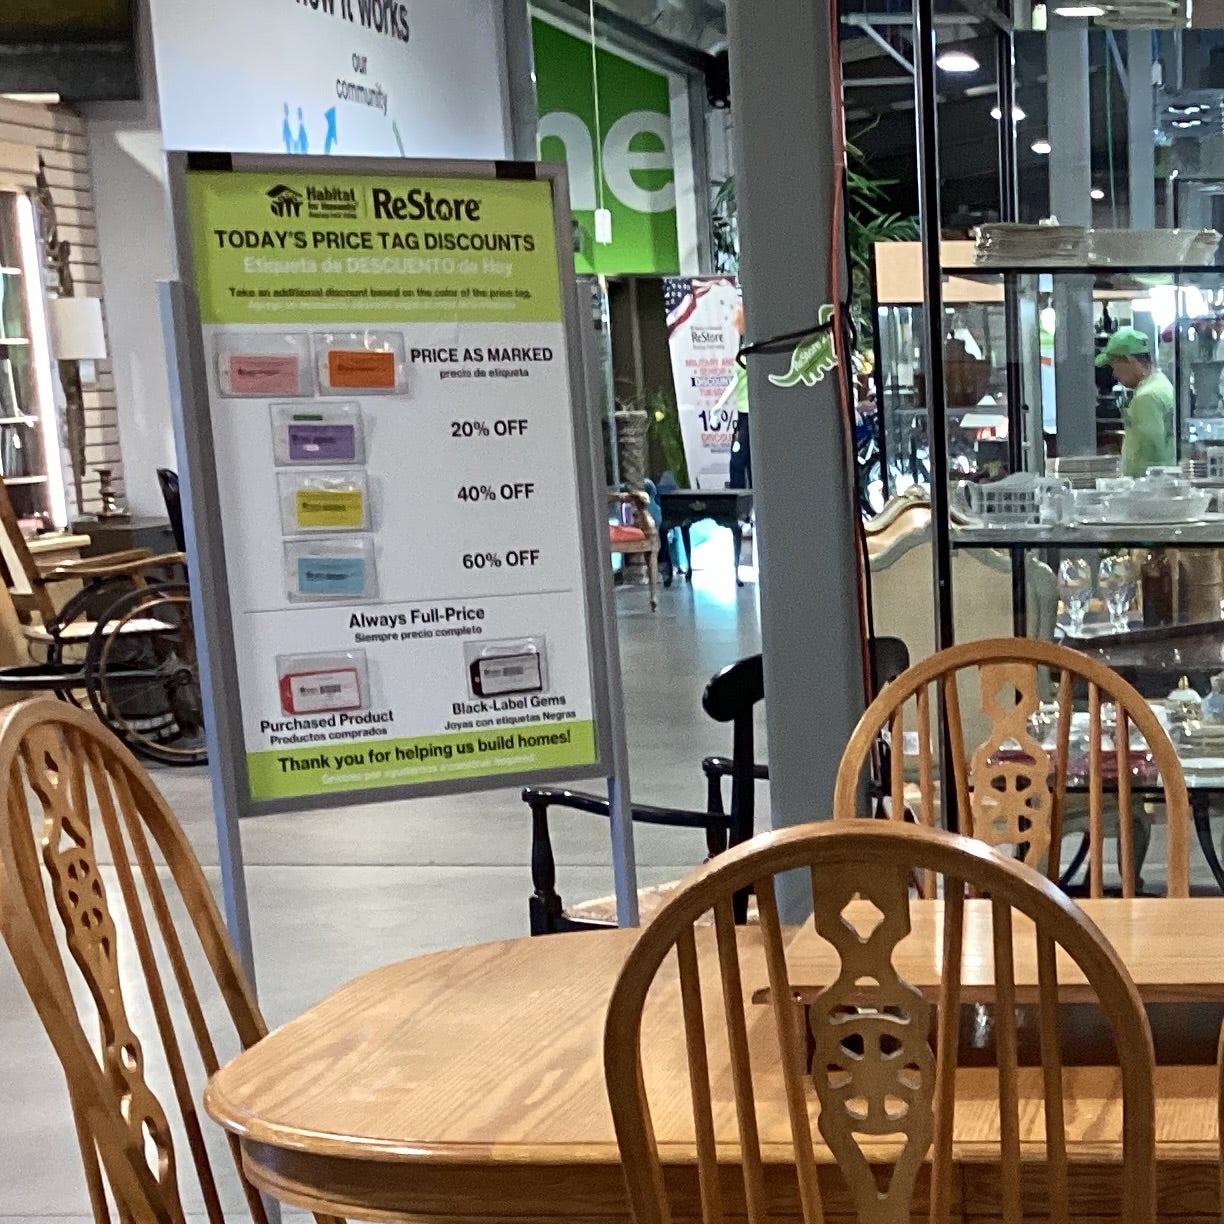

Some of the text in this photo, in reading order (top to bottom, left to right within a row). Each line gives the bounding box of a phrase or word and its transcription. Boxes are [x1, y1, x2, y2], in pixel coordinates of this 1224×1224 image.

[358, 0, 410, 43] works
[352, 52, 368, 75] our
[336, 78, 388, 117] community
[306, 185, 481, 222] Habitat ReStore
[214, 229, 536, 252] TODAY'S PRICE TAG DISCOUNTS
[347, 257, 455, 274] DESCUENTO
[228, 286, 256, 298] Take
[258, 288, 272, 298] an
[273, 287, 323, 298] additional
[325, 287, 368, 298] discount
[370, 287, 400, 298] based
[402, 289, 415, 298] on
[416, 288, 432, 298] the
[460, 287, 471, 298] of
[472, 287, 488, 298] the
[489, 289, 513, 300] price
[410, 347, 554, 364] PRICE AS MARKED
[439, 367, 530, 380] precio de etiqueta
[450, 420, 529, 438] 20% OFF
[457, 483, 535, 502] 40% OFF
[462, 549, 540, 570] 60% OFF
[349, 606, 486, 629] Always Full-Price
[354, 625, 483, 643] Siempre precio completo
[452, 694, 567, 716] Black-Label Gems
[260, 709, 395, 734] Purchased Product
[444, 709, 577, 732] Joyas con etiquetas Negras
[269, 727, 388, 746] Productos comprados
[277, 753, 331, 773] Thank
[335, 754, 366, 770] you
[368, 748, 391, 763] for
[395, 743, 453, 763] helping
[456, 741, 475, 754] us
[477, 735, 515, 752] build
[518, 729, 571, 748] homes!
